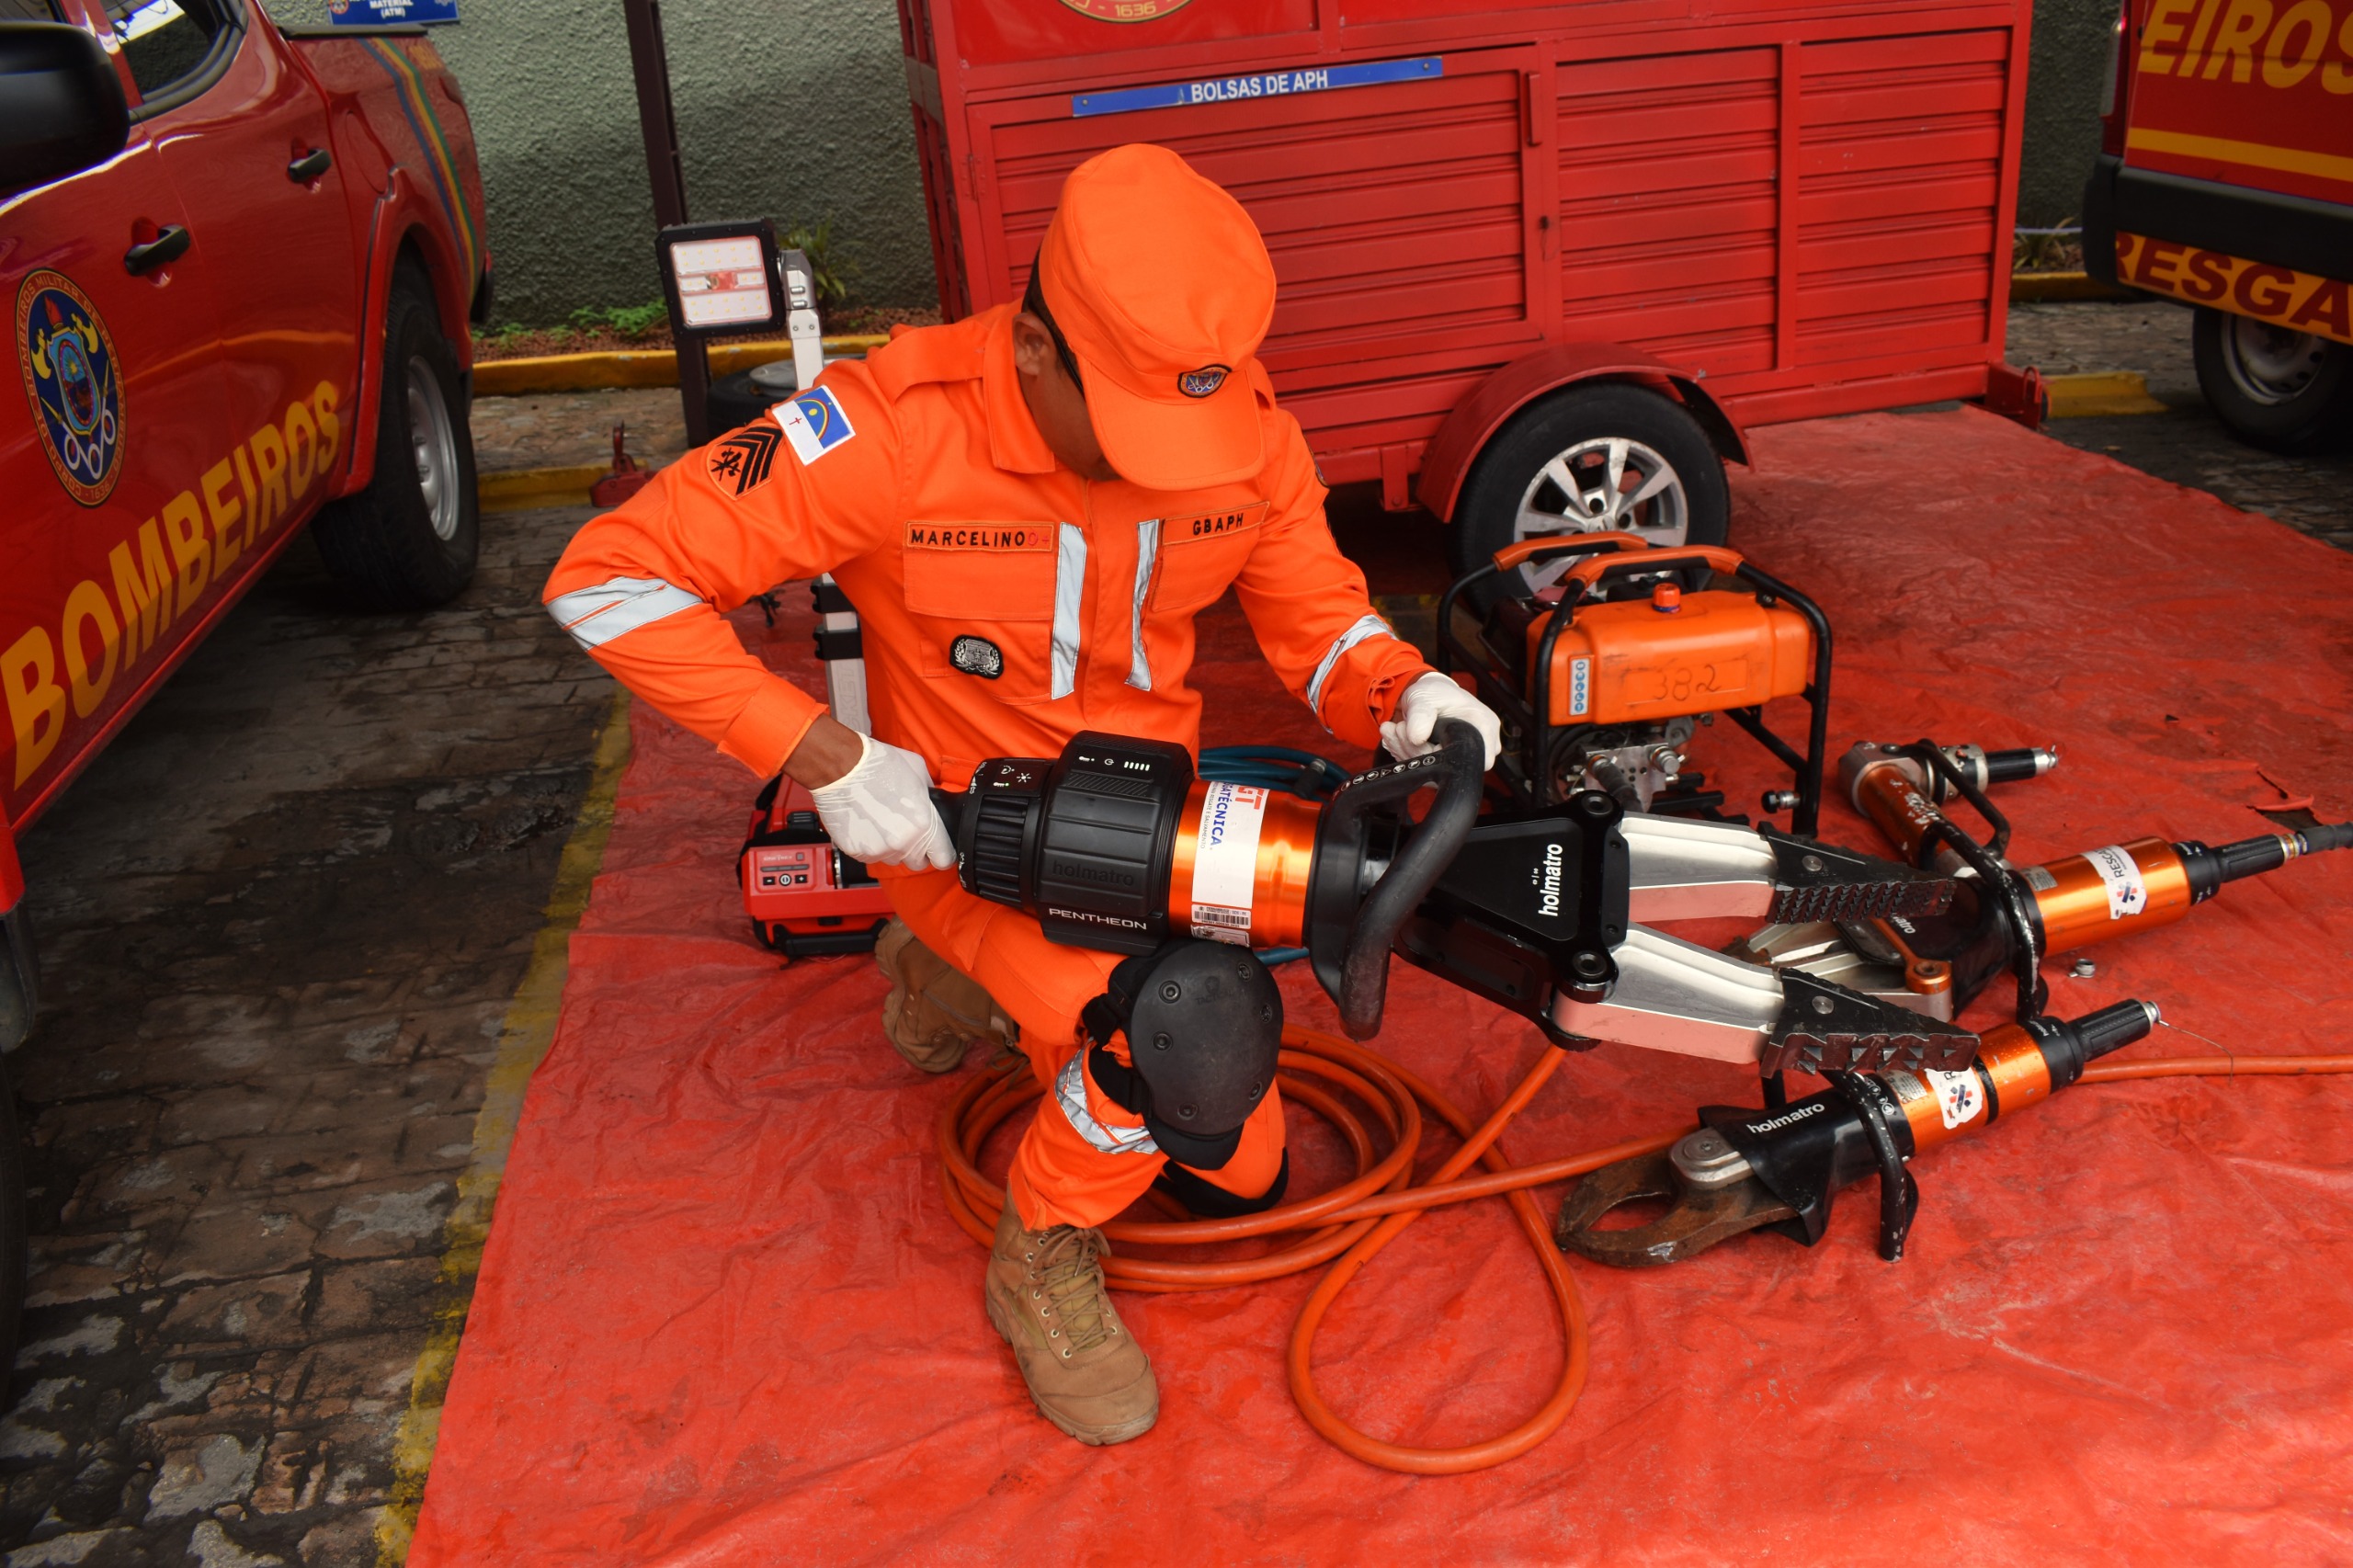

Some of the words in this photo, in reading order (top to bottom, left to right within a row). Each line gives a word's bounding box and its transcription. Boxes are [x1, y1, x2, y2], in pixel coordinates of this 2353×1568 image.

[1115, 1, 1156, 17] 1636
[1191, 77, 1261, 103] BOLSAS
[1266, 74, 1290, 95] DE
[1293, 69, 1328, 92] APH
[35, 275, 79, 299] MILITAR
[911, 529, 1026, 547] MARCELINO
[1193, 513, 1244, 536] GBAPH
[0, 380, 339, 791] BOMBEIROS
[1654, 665, 1721, 701] 382
[1052, 860, 1135, 887] holmatro
[1538, 844, 1563, 917] holmatro
[1049, 908, 1148, 930] PENTHEON
[1745, 1102, 1825, 1134] holmatro
